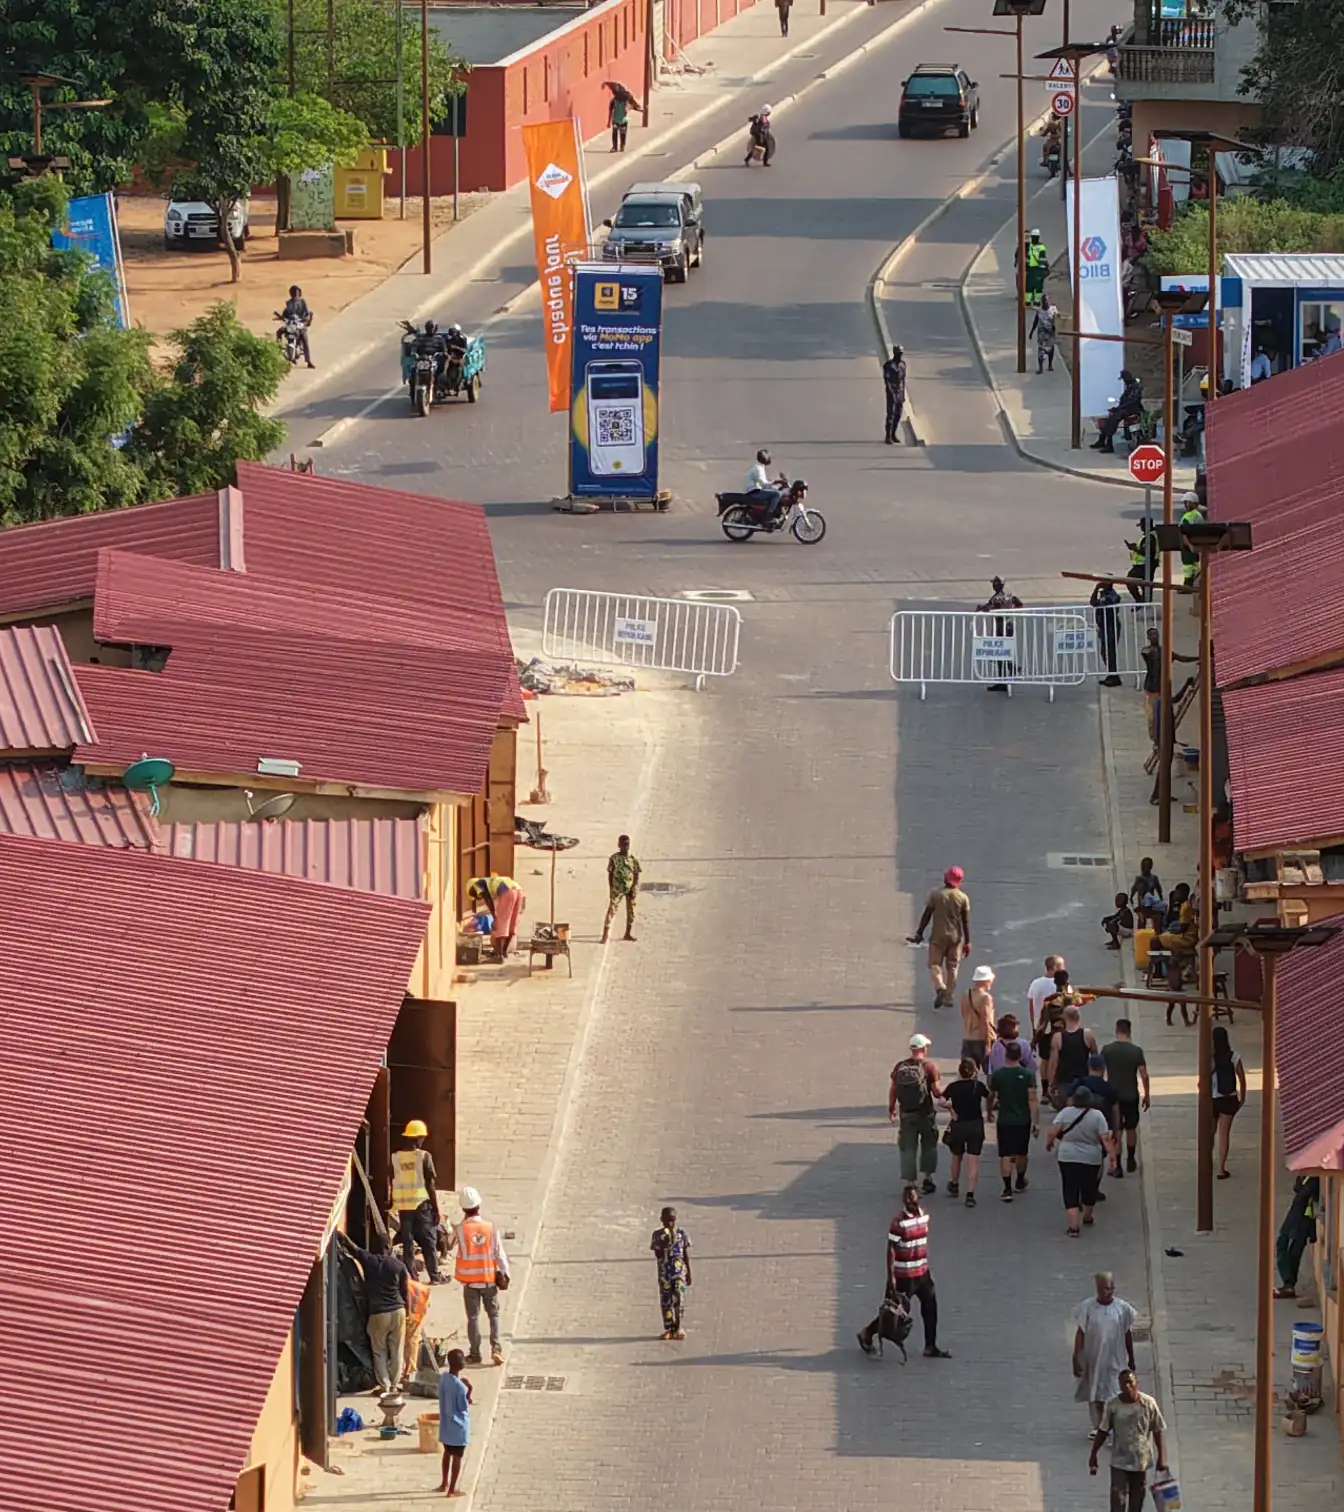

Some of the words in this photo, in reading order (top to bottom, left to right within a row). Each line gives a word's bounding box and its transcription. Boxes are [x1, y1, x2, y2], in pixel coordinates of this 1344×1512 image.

[1057, 98, 1070, 109] 30
[621, 287, 638, 300] 15
[580, 324, 596, 333] Tes
[597, 325, 657, 334] transactions
[583, 333, 597, 341] via
[632, 334, 654, 344] app
[591, 341, 614, 350] c'est
[1133, 459, 1163, 470] STOP
